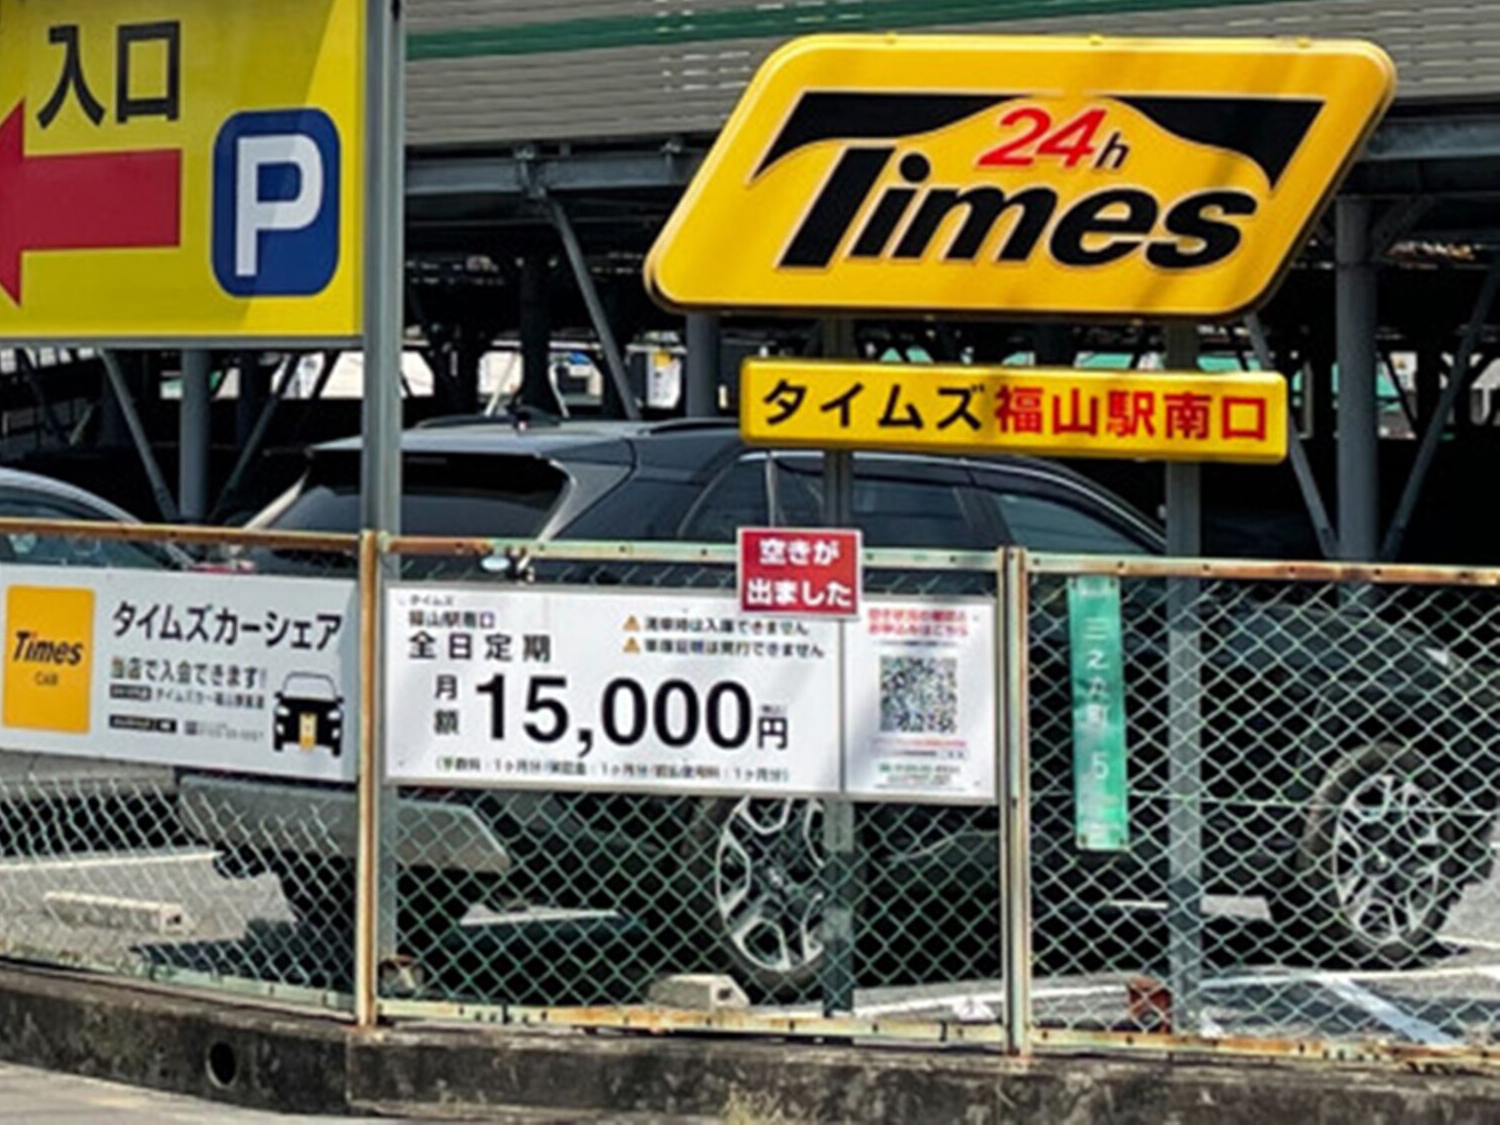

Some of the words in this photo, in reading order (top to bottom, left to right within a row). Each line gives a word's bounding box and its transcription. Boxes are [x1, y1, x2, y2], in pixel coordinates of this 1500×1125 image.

[37, 20, 181, 129] 入口
[976, 107, 1130, 170] 24h
[235, 134, 323, 276] P
[777, 145, 1258, 271] Times
[761, 379, 1268, 443] タイムズ福山駅南口
[758, 538, 840, 566] 空きが
[746, 577, 852, 607] 出ました
[13, 631, 84, 667] Times
[111, 600, 343, 652] タイムズカーシェア
[409, 630, 552, 663] 全日定期
[434, 674, 459, 736] 月額
[475, 673, 789, 758] 15,000円
[1092, 751, 1109, 780] 5
